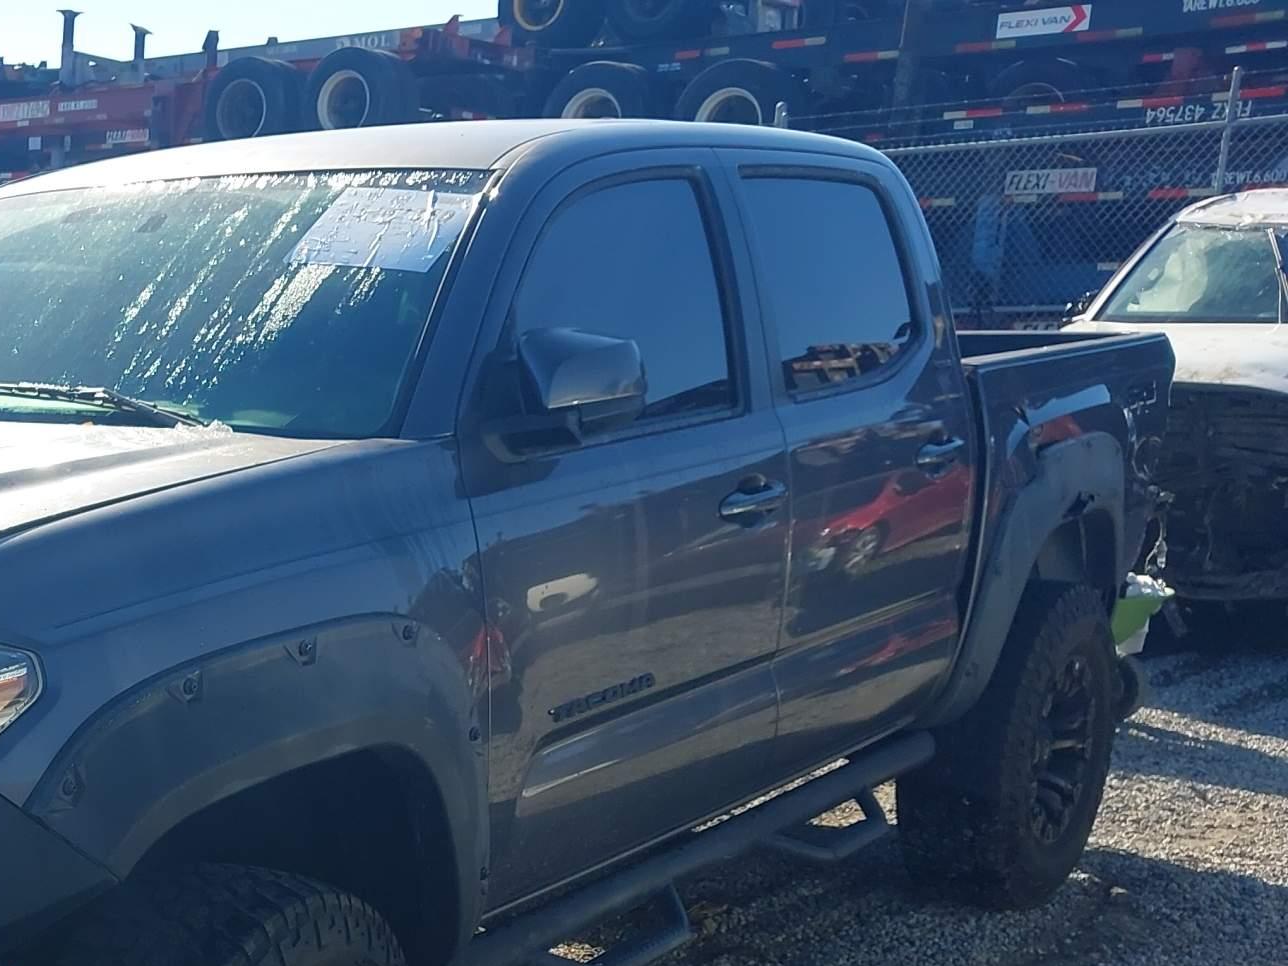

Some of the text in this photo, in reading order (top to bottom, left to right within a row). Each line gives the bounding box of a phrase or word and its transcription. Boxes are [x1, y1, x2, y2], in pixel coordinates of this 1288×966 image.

[1000, 15, 1071, 30] FLEXI VAN
[1145, 104, 1206, 124] 437564
[1007, 170, 1095, 192] FLEXI-VAN
